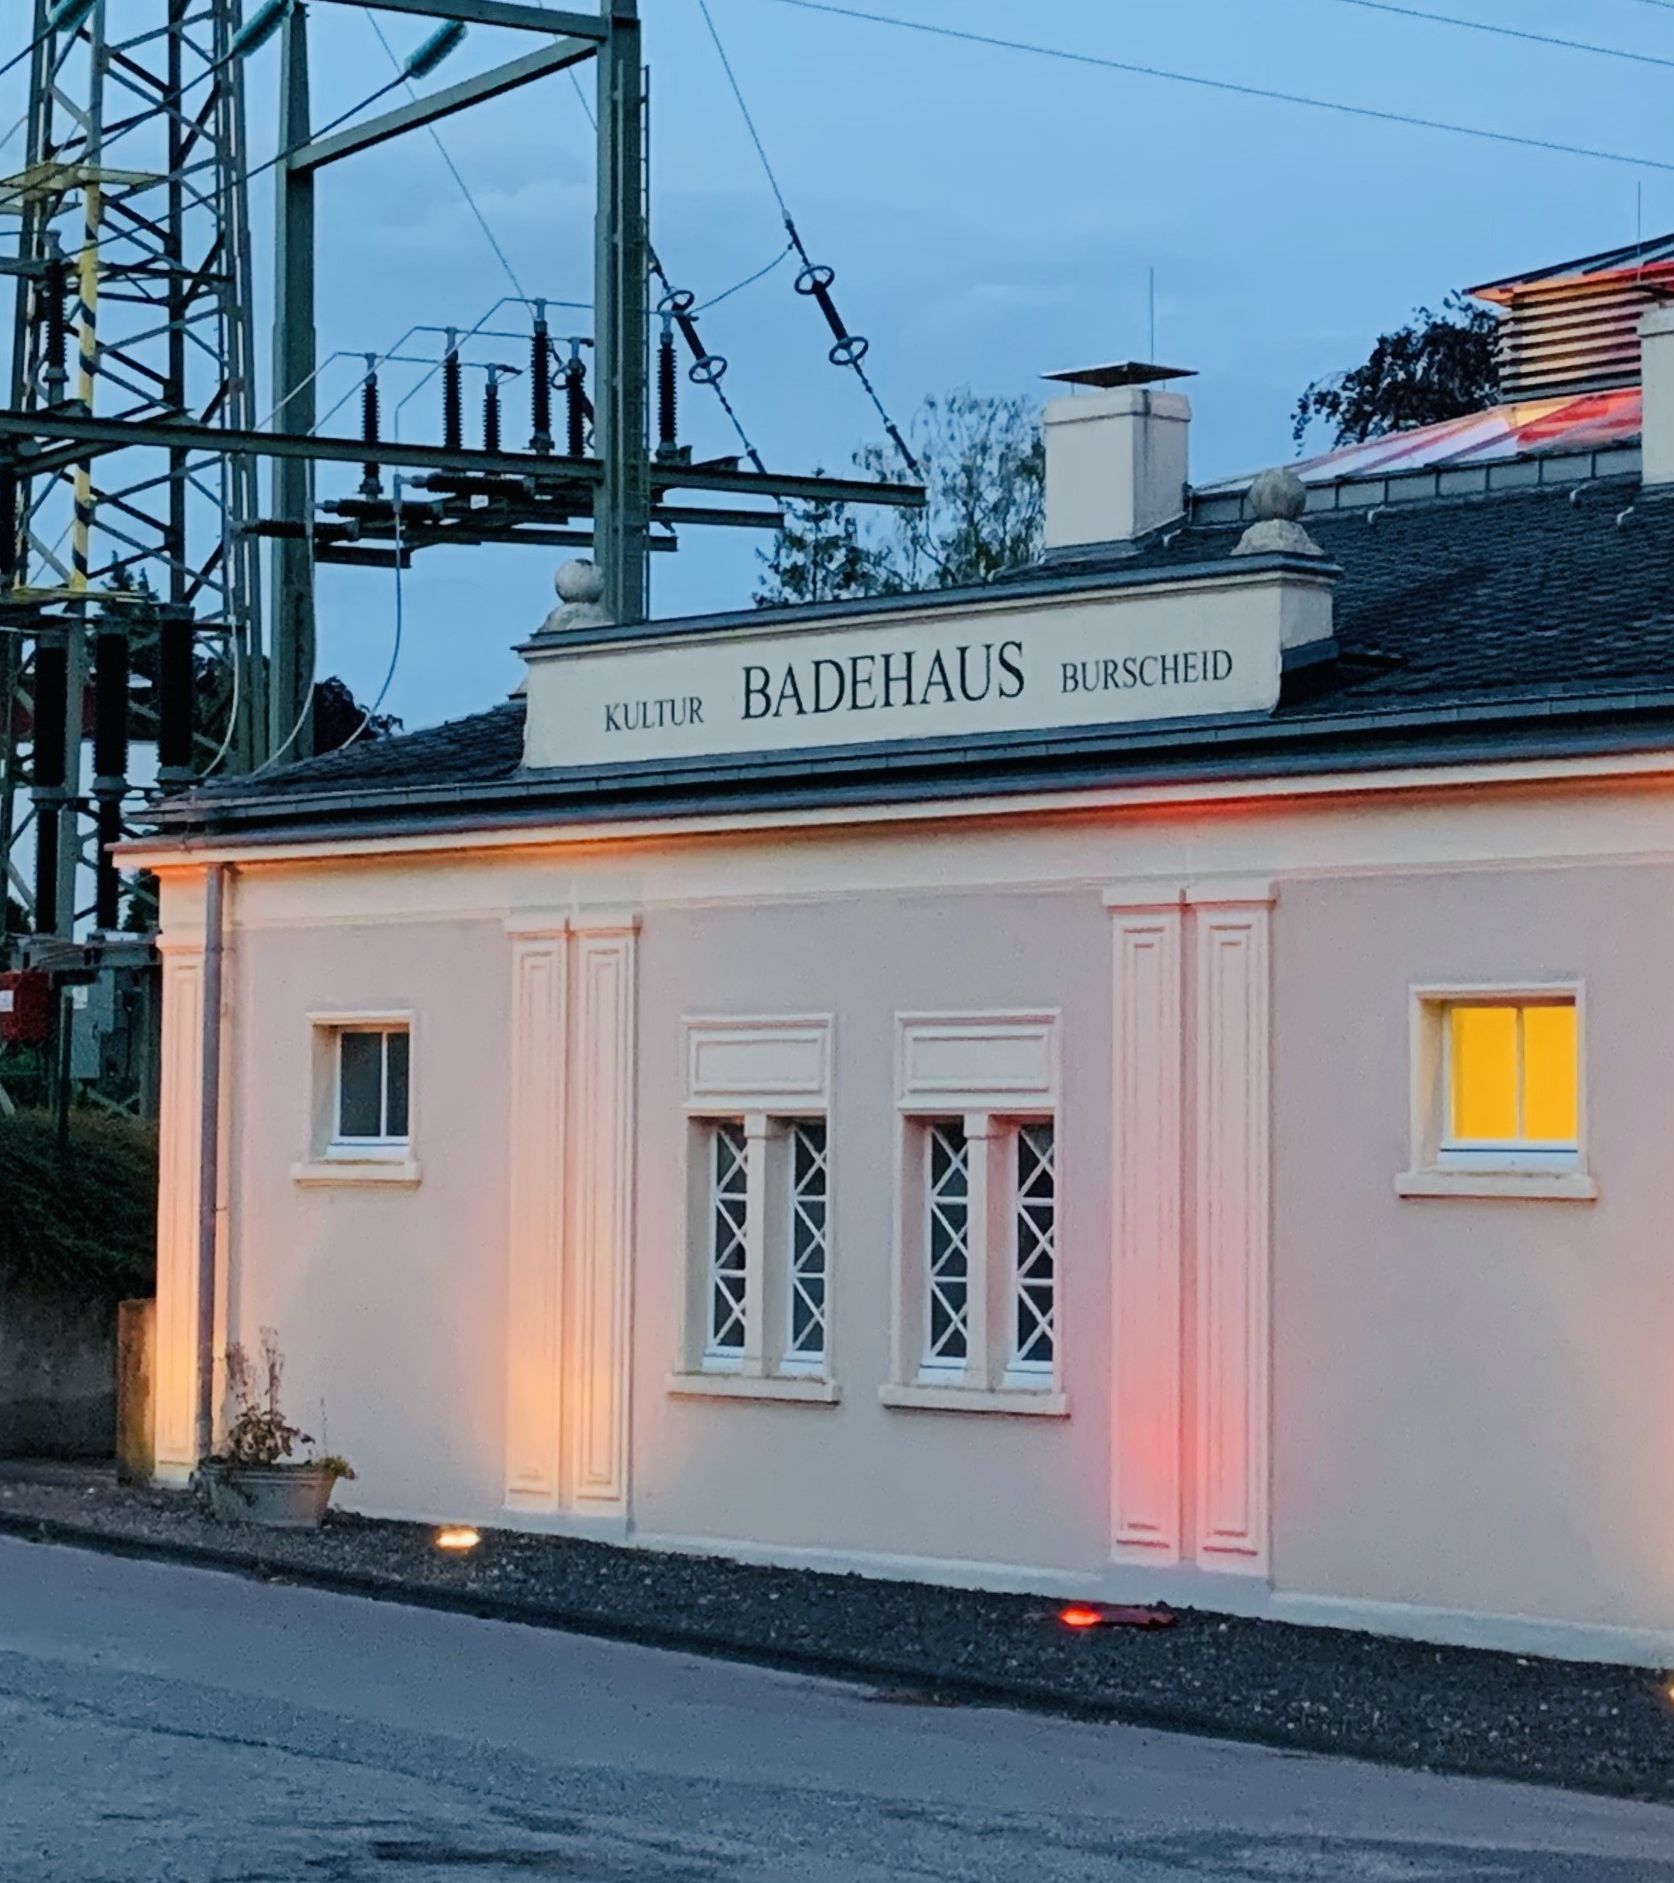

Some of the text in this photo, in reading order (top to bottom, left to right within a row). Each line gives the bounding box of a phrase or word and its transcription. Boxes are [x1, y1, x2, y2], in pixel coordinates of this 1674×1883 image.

[604, 640, 1233, 732] KULTUR BADEHAUS BURSCHEID
